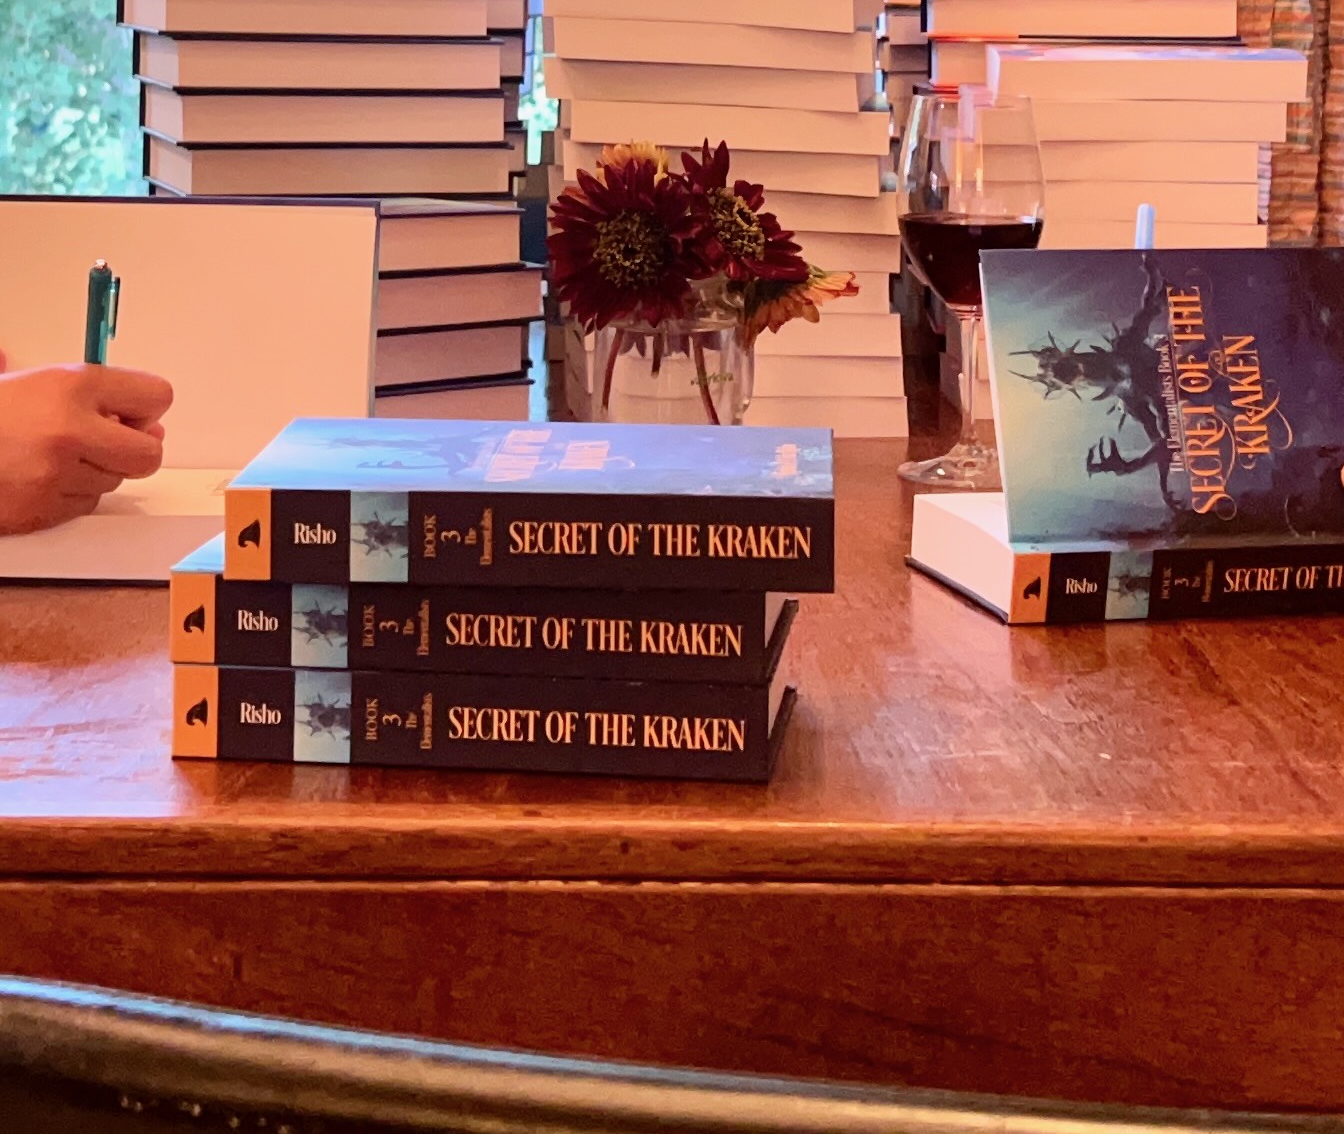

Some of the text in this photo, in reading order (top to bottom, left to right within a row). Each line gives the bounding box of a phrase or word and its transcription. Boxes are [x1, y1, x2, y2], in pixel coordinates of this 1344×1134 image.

[1156, 343, 1172, 372] Book
[1161, 375, 1182, 449] Elementalists
[1166, 286, 1237, 521] SECRET OF THE
[1211, 335, 1293, 470] KRAKEN
[1168, 451, 1185, 473] The
[293, 522, 337, 545] Risho
[423, 514, 437, 558] BOOK
[440, 530, 462, 543] 3
[509, 521, 603, 555] SECRET
[607, 522, 643, 556] OF
[648, 523, 701, 557] THE
[707, 524, 812, 559] KRAKEN
[1065, 577, 1098, 595] Risho
[1223, 567, 1293, 593] SECRET
[1295, 566, 1320, 589] OF
[237, 609, 279, 632] Risho
[362, 604, 375, 647] BOOK
[378, 620, 399, 633] 3
[445, 612, 538, 649] SECRET
[542, 616, 576, 650] OF
[581, 618, 633, 653] THE
[640, 621, 744, 657] KRAKEN
[239, 701, 282, 725] Risho
[365, 698, 379, 741] BOOK
[381, 713, 402, 727] 3
[448, 705, 541, 742] SECRET
[545, 710, 579, 744] OF
[585, 712, 636, 747] THE
[643, 715, 745, 752] KRAKEN
